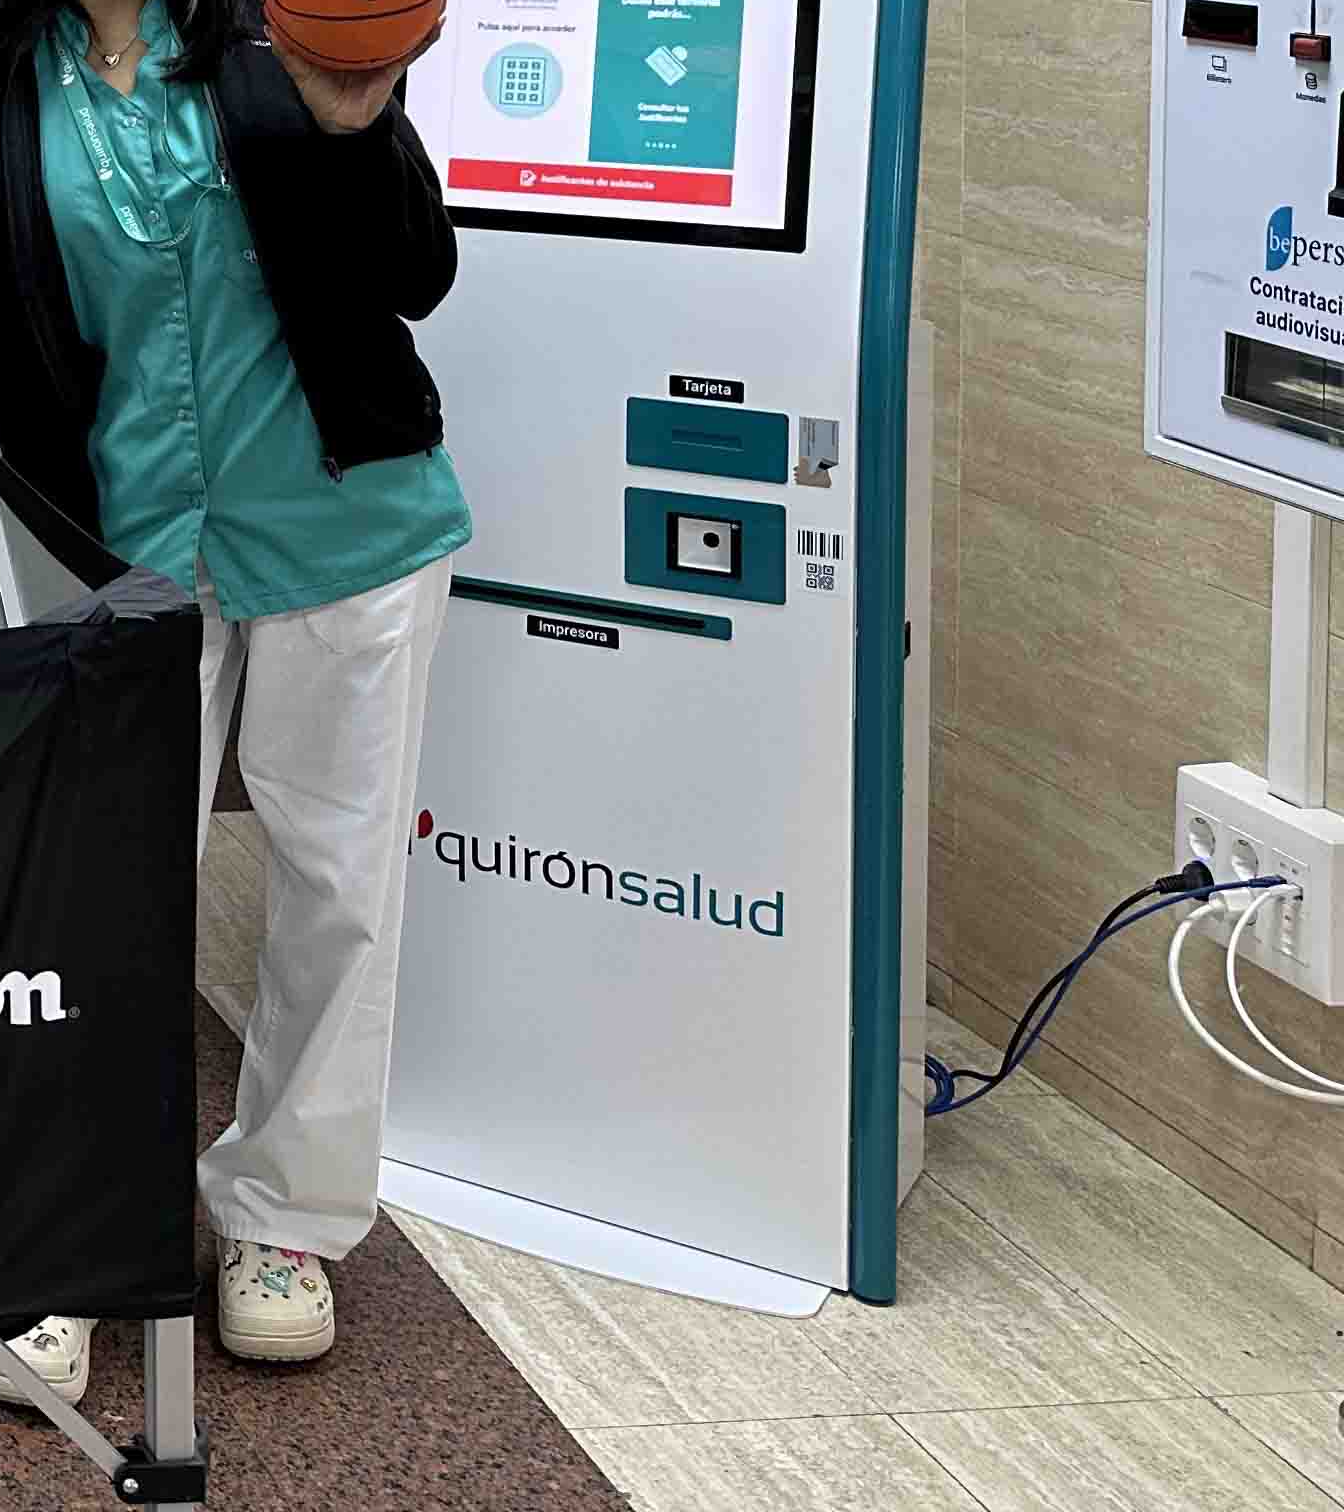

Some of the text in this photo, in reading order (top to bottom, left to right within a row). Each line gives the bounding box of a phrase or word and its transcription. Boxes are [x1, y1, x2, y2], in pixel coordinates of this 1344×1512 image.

[1250, 276, 1344, 316] Contrataci
[681, 378, 733, 397] Tarjeta
[538, 619, 608, 643] Impresora
[435, 830, 784, 937] quirónsalud
